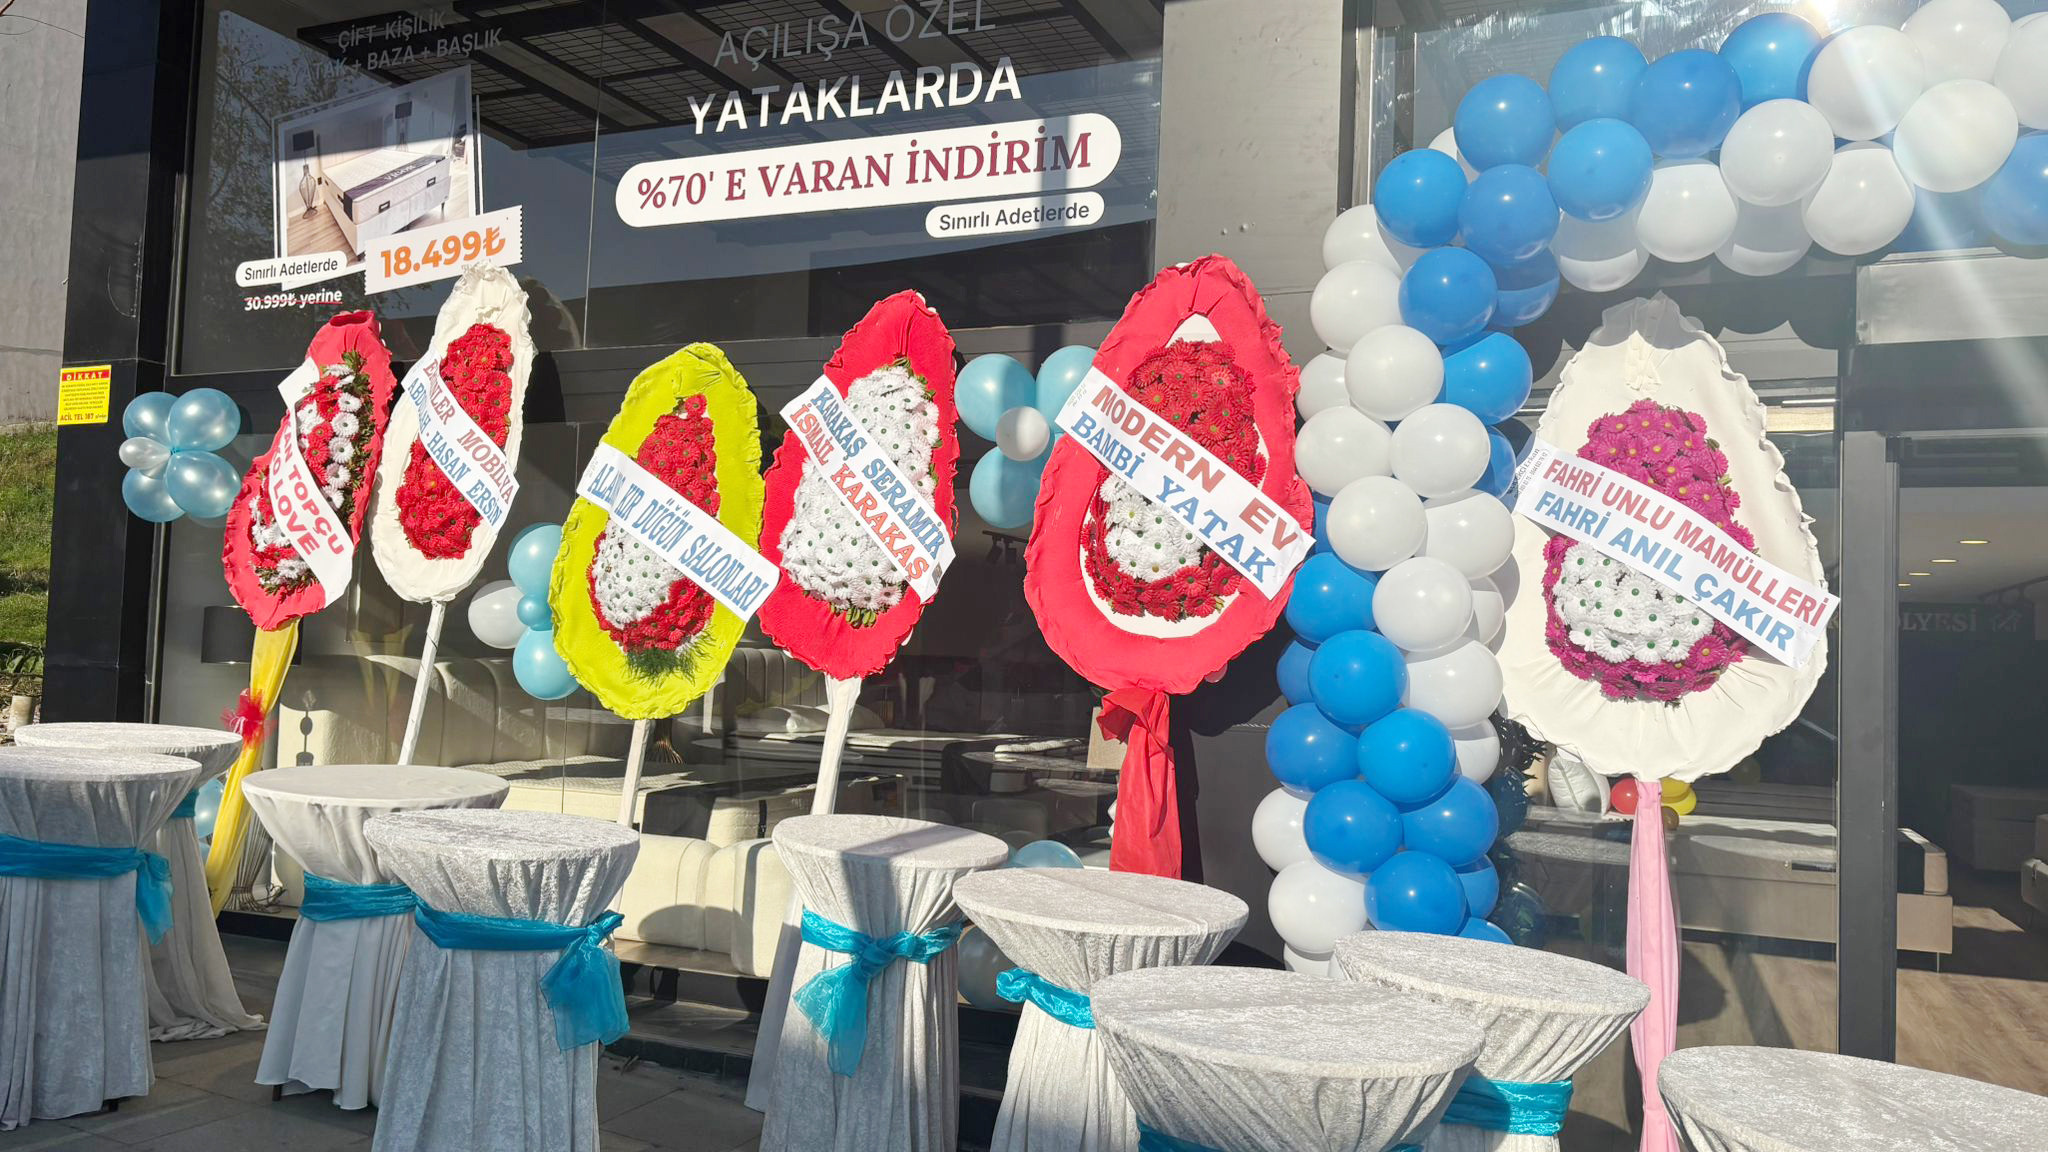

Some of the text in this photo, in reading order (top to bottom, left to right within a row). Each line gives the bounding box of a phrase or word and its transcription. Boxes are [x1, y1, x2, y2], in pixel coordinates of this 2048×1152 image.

[338, 9, 446, 53] ÇİFT KİŞİLİK
[367, 45, 415, 70] BAZA
[437, 27, 502, 57] BAŞLIK
[713, 22, 870, 69] AÇILIŞA
[686, 56, 1022, 135] YATAKLARDA
[637, 125, 1092, 210] %70' E VARAN İNDİRİM
[380, 226, 506, 279] 18.499₺
[939, 202, 1090, 231] Sınırlı Adetlerde
[244, 258, 338, 281] Sınırlı Adetlerde
[299, 288, 343, 309] yerine
[457, 428, 515, 505] MOBİLYA
[790, 403, 835, 466] İSMAİL
[811, 386, 945, 560] KARAKAŞ SERAMİK
[1091, 385, 1299, 551] MODERN EV
[273, 478, 320, 556] LOVE
[288, 463, 345, 556] TOPÇU
[427, 430, 471, 483] HASAN
[466, 479, 503, 527] ERSİN
[1071, 411, 1276, 584] BAMBİ YATAK
[613, 482, 646, 522] KIR
[632, 497, 694, 553] DÜĞÜN
[678, 534, 770, 613] SALONLARI
[1534, 491, 1796, 652] FAHRİ ANIL ÇAKIR
[1543, 458, 1604, 498] FAHRİ
[1601, 481, 1675, 531] UNLU
[1673, 519, 1830, 628] MAMÜLLERİ
[1899, 608, 1977, 632] LYESİ
